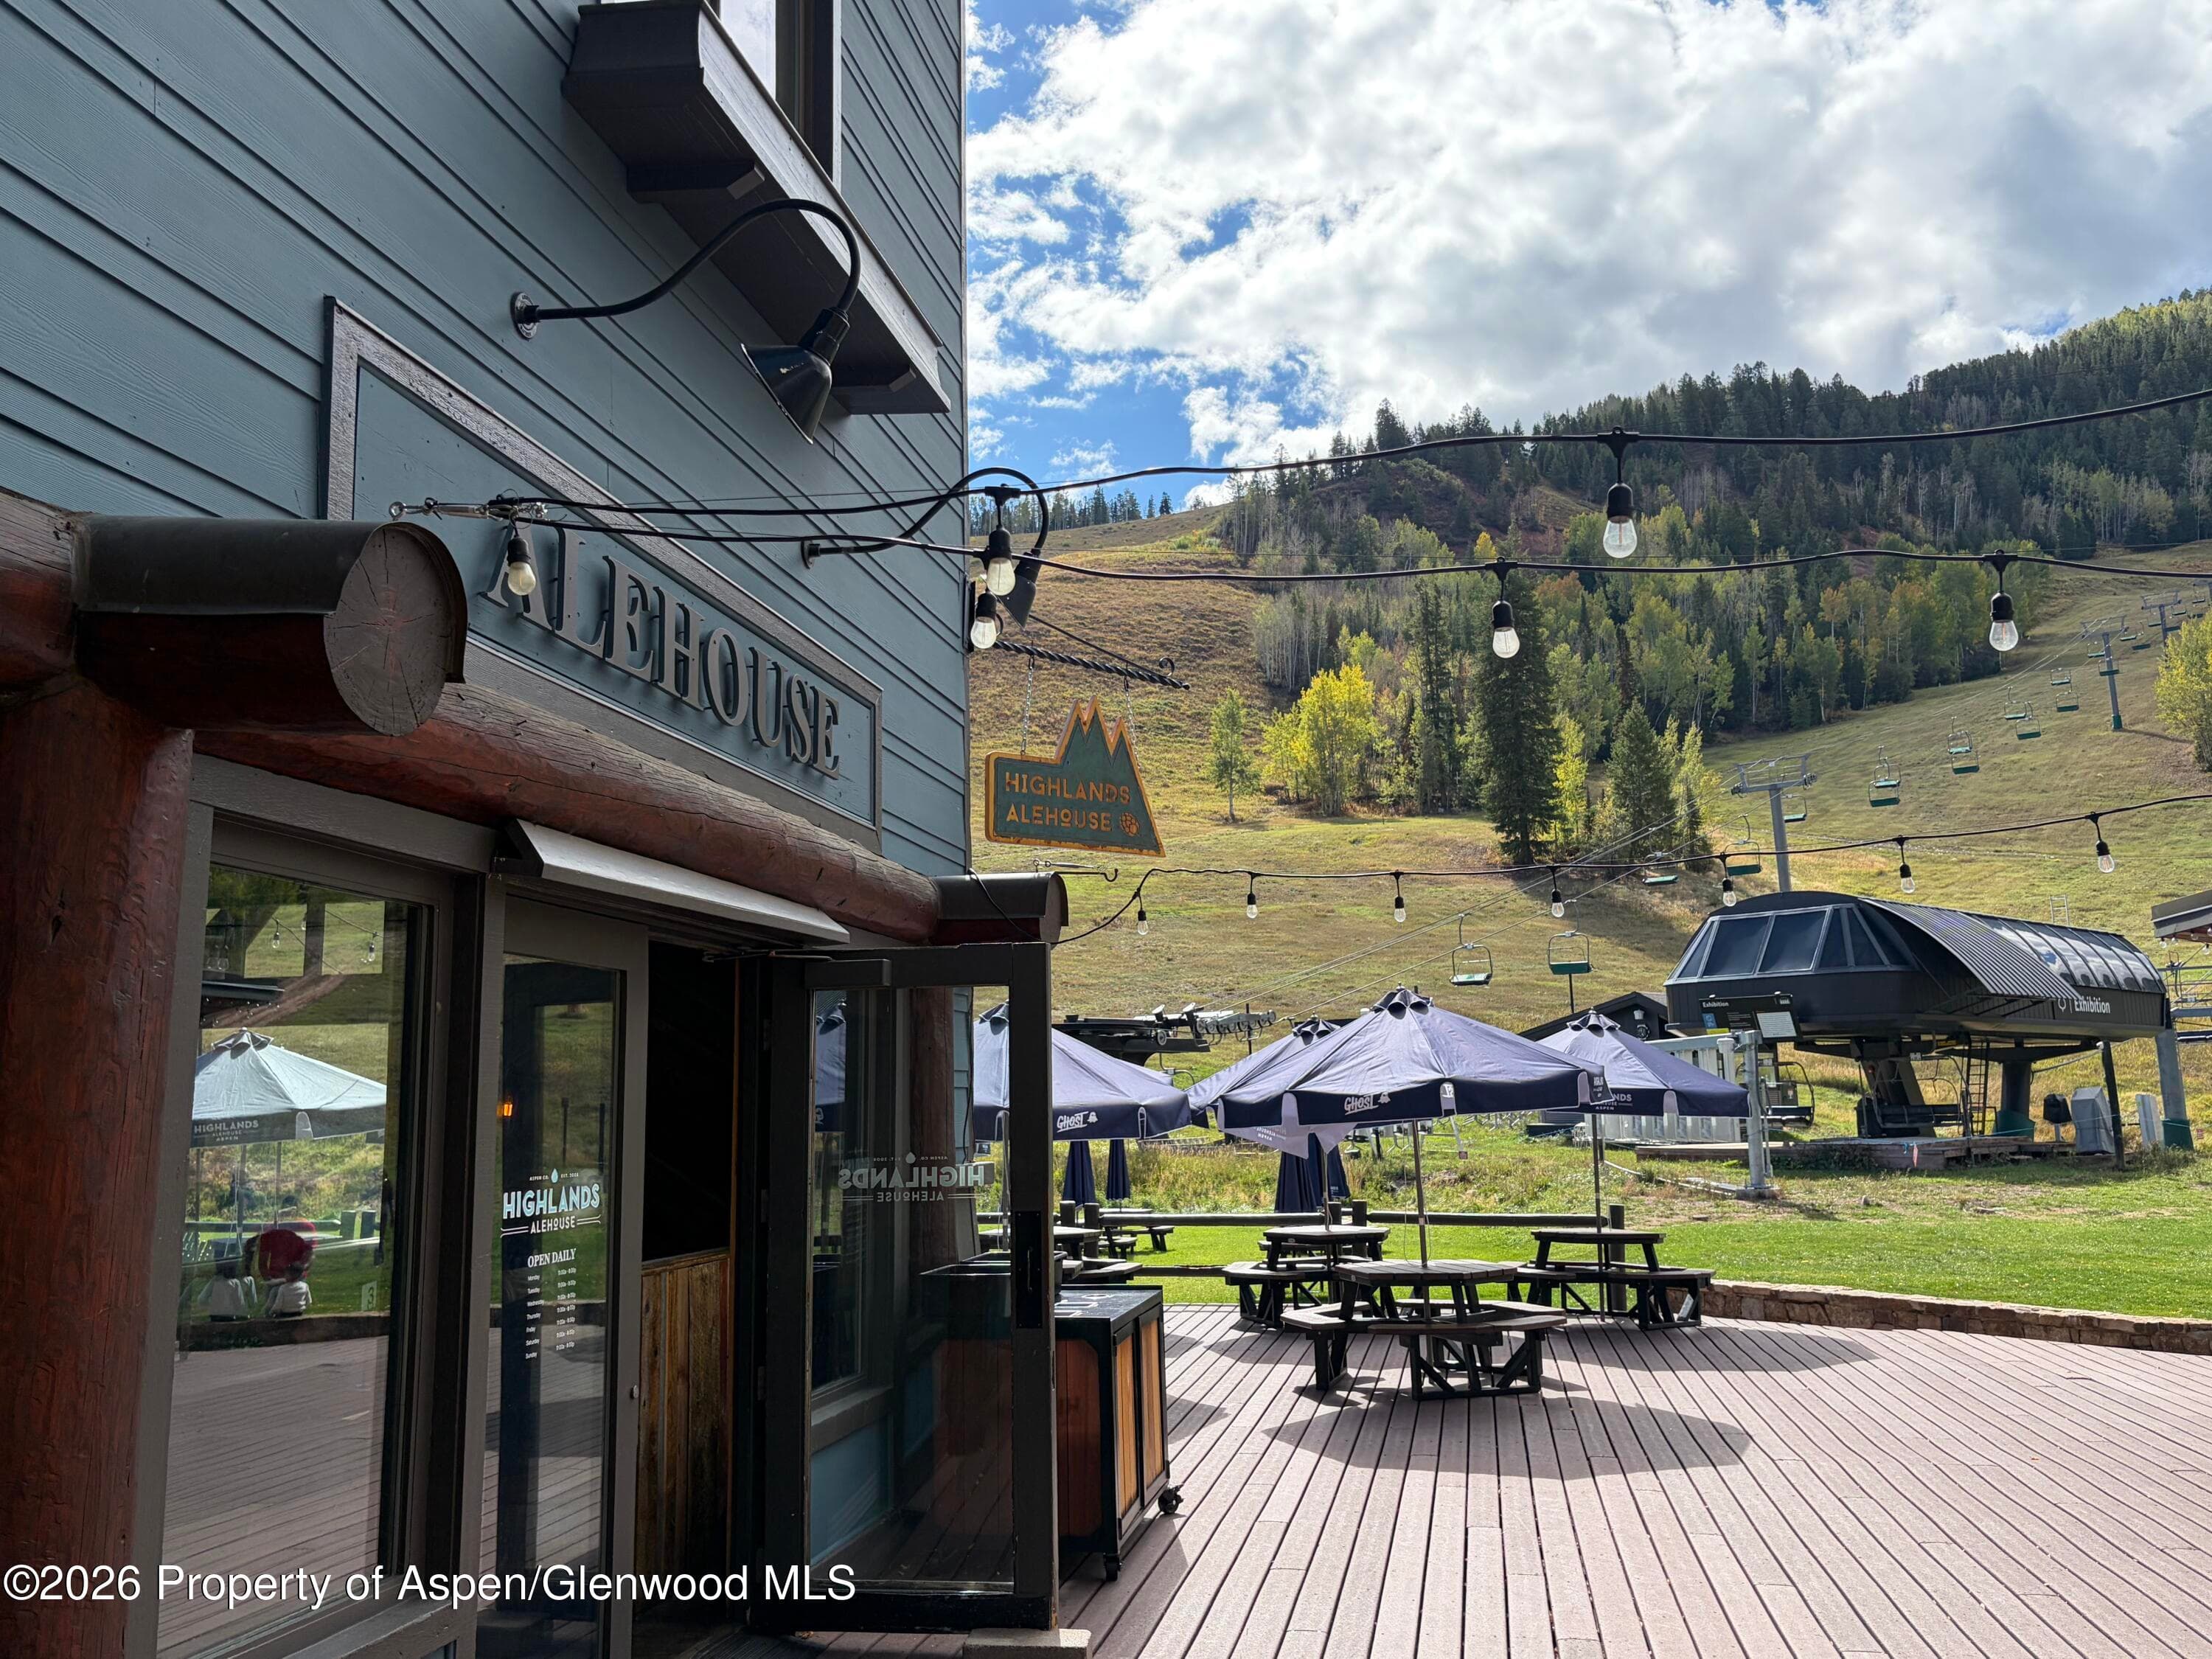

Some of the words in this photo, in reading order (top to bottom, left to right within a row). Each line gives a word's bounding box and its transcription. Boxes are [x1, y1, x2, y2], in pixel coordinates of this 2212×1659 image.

[481, 518, 839, 780] ALEHOUSE
[1005, 771, 1131, 805] HIGHLANDS
[1006, 803, 1113, 832] ALEHOUSE
[2073, 995, 2111, 1014] Exhibition
[1344, 1093, 1379, 1116] GHOST
[194, 1119, 260, 1134] HIGHLANDS
[1056, 1110, 1089, 1133] GHOST
[503, 1183, 600, 1220] HIGHLANDS
[530, 1215, 576, 1234] ALEHOUSE
[527, 1253, 551, 1268] OPEN
[552, 1248, 577, 1264] DAILY
